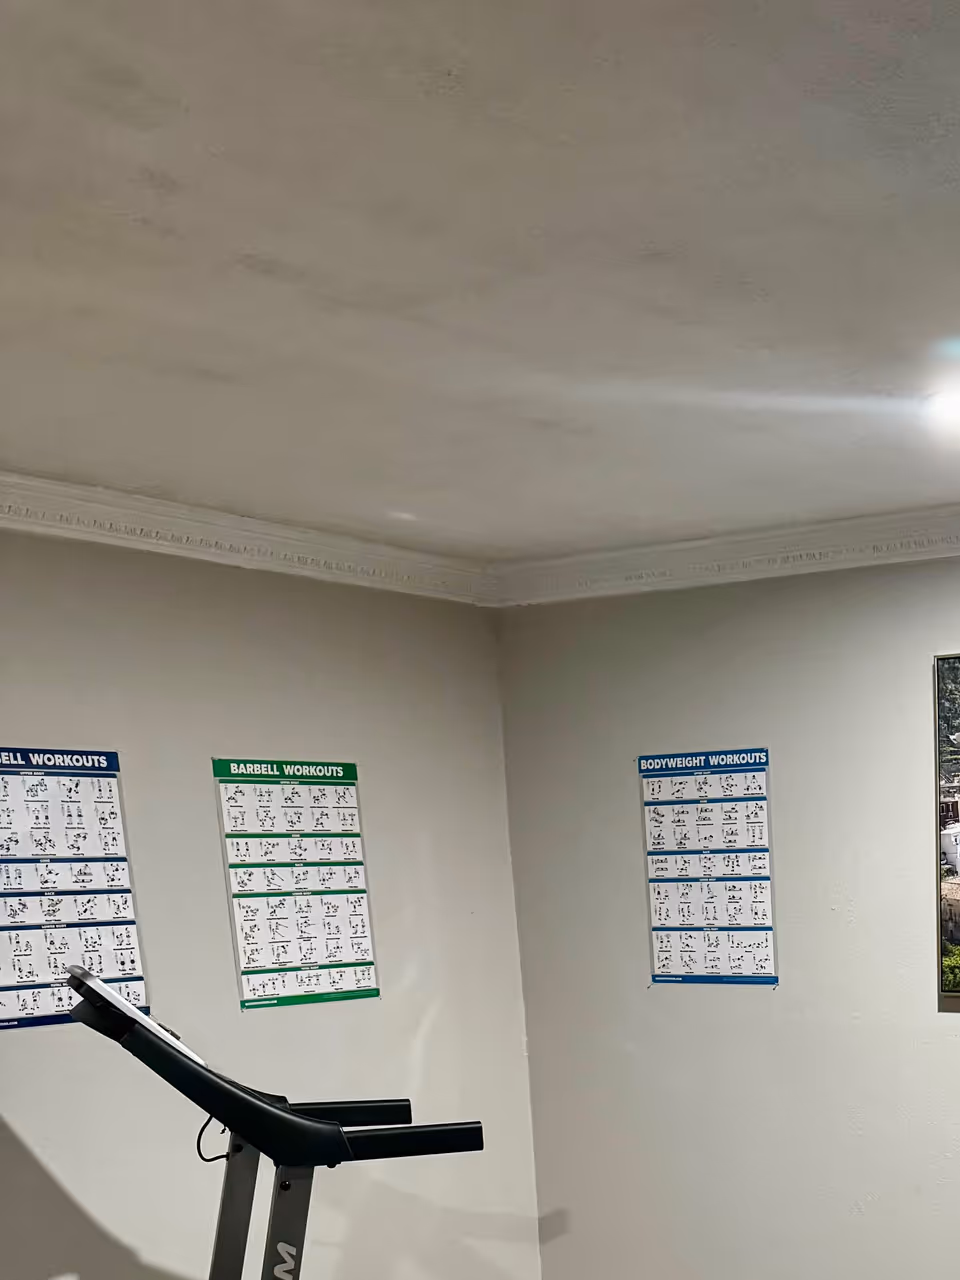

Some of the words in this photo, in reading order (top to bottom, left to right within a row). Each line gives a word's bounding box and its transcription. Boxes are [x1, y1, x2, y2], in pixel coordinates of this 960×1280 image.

[0, 751, 26, 765] ELL
[28, 752, 108, 768] WORKOUTS
[640, 756, 706, 770] BODYWEIGHT
[708, 752, 767, 766] WORKOUTS
[230, 763, 280, 775] BARBELL
[283, 764, 344, 777] WORKOUTS
